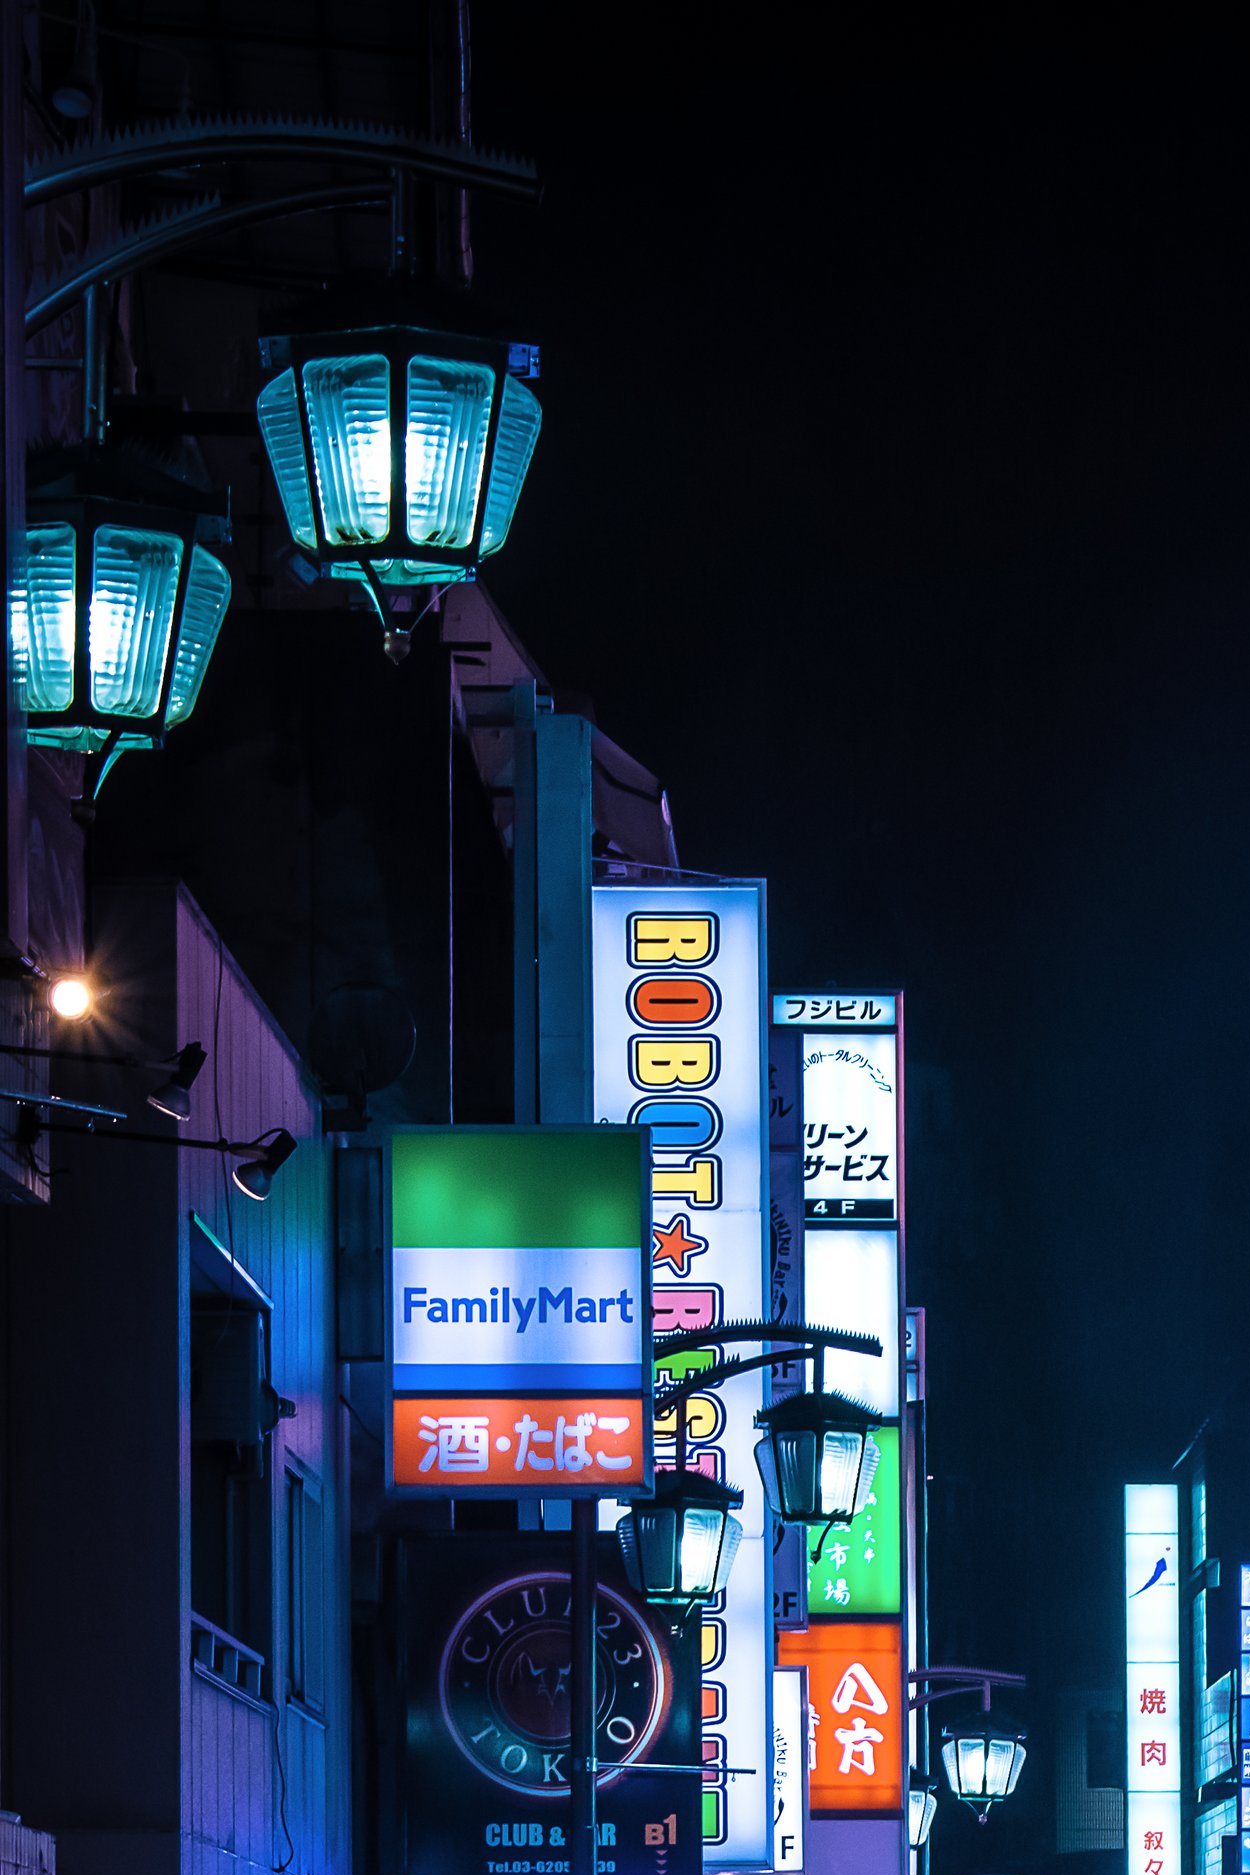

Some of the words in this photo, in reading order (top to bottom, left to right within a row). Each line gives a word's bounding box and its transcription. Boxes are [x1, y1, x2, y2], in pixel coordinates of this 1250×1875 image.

[786, 999, 882, 1021] フジビル
[626, 910, 723, 1210] ROBOT
[402, 1287, 634, 1333] FamilyMart
[417, 1412, 633, 1476] 酒・たばこ
[470, 1716, 636, 1784] TOKO
[1139, 1688, 1167, 1767] 焼肉
[485, 1823, 544, 1847] CLUB
[549, 1825, 566, 1846] &
[644, 1813, 678, 1846] B1
